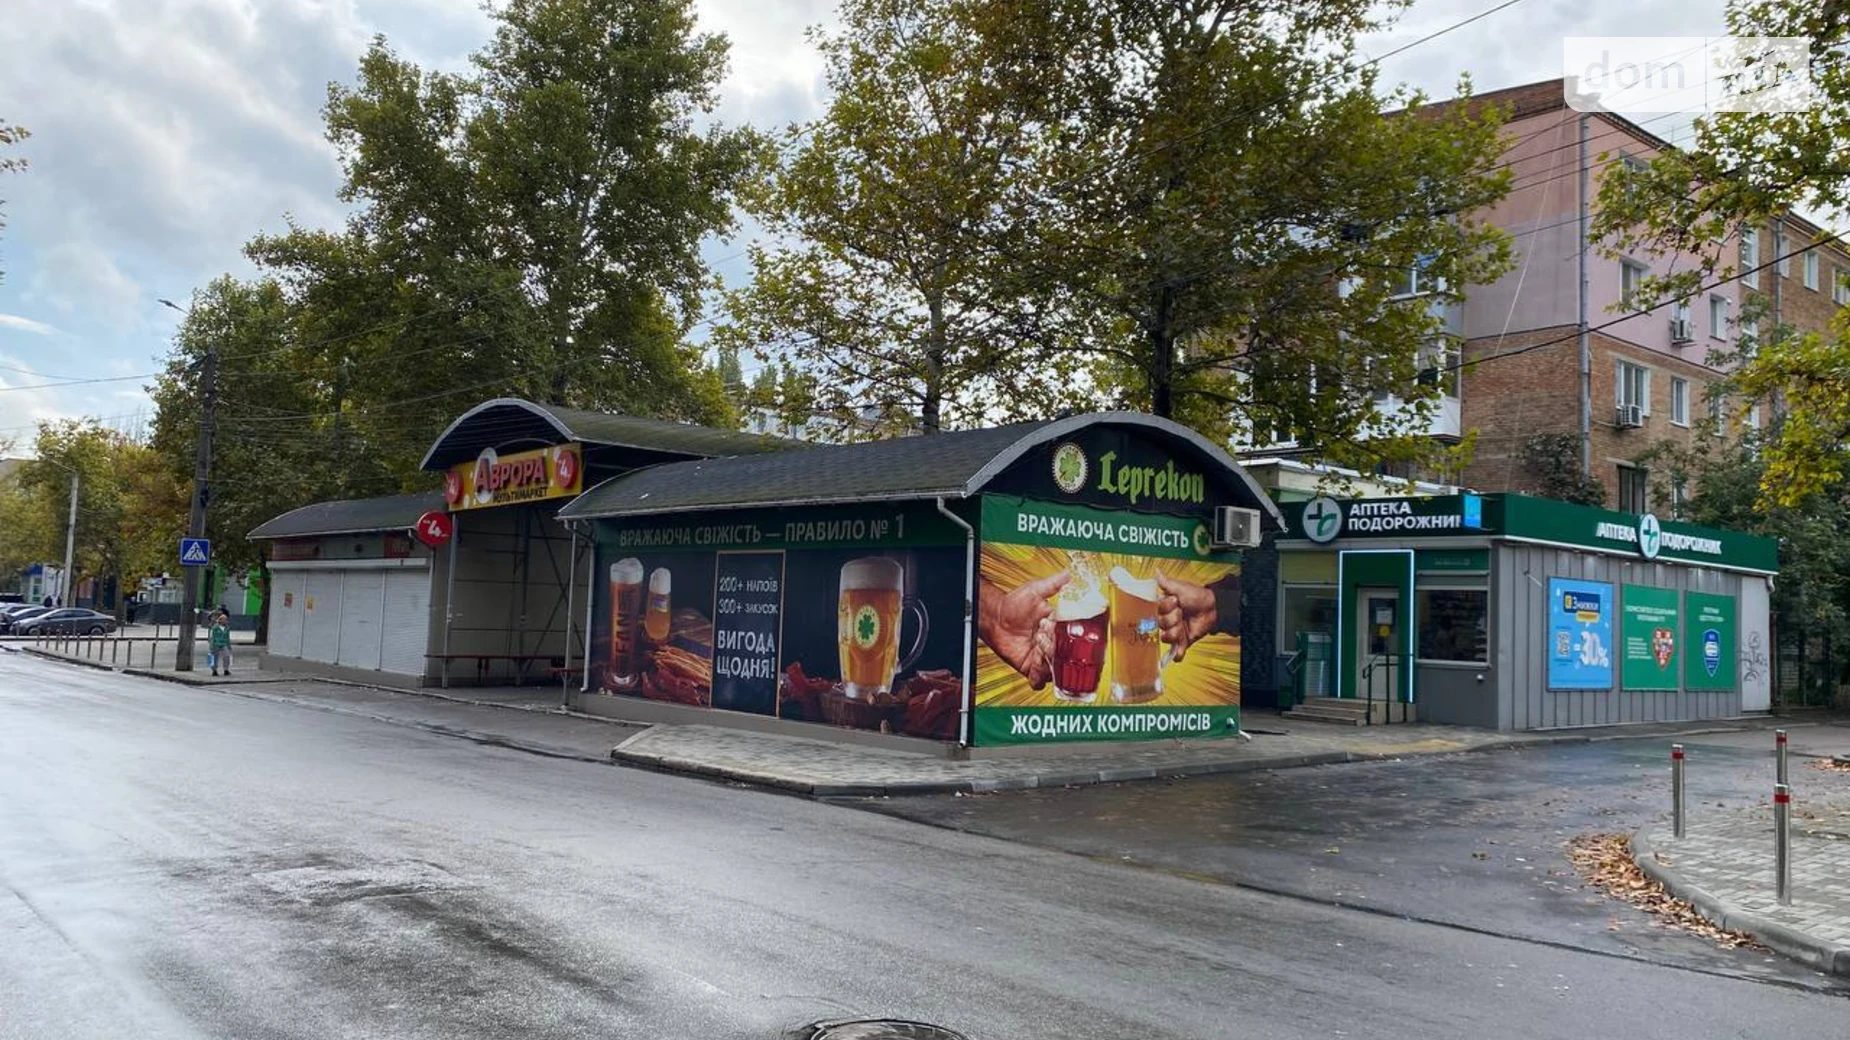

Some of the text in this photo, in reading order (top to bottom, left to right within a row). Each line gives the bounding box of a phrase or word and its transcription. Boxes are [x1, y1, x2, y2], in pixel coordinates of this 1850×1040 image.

[475, 457, 546, 493] АВРОРА
[1098, 450, 1204, 504] Leprekon
[1349, 501, 1412, 516] АПТЕКА
[427, 520, 442, 537] 4
[619, 527, 691, 547] ВРАЖАЮЧА
[694, 524, 761, 544] СВІЖІСТЬ
[785, 519, 865, 542] ПРАВИЛО
[870, 519, 889, 540] №
[895, 514, 904, 539] 1
[1017, 513, 1189, 548] ВРАЖАЮЧА СВІЖІСТЬ
[1596, 522, 1722, 555] АПТЕКА ПОДОРОЖНИК
[719, 576, 778, 592] 200+ НАПОЇВ
[718, 599, 742, 614] 300+
[717, 630, 775, 655] ВИГОДА
[1574, 631, 1609, 668] -30%
[716, 656, 776, 679] ЩОДНЯ!
[1011, 713, 1211, 737] ЖОДНИХ КОМПРОМІСІВ
